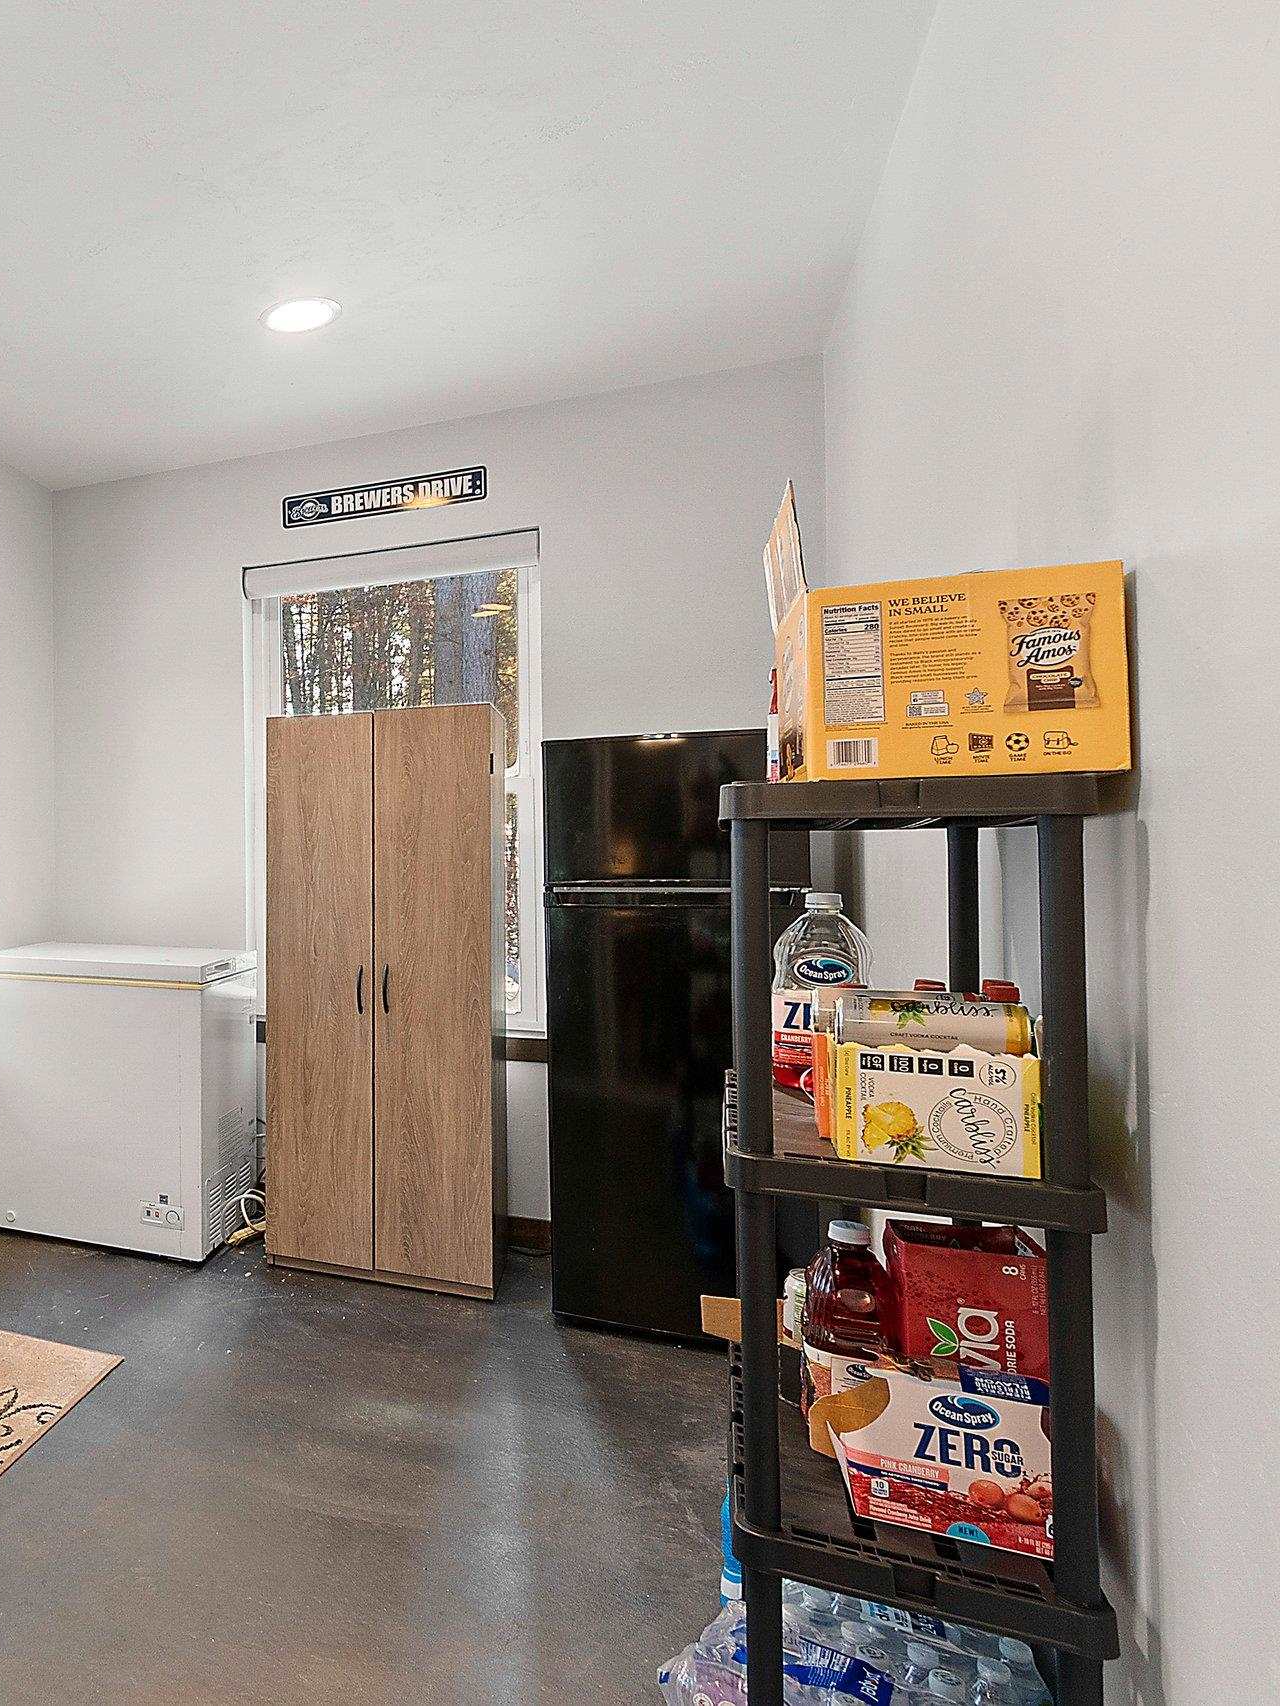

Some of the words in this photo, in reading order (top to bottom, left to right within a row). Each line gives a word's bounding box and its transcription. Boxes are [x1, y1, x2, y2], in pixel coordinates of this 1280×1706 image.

[331, 484, 415, 514] BREWERS
[418, 475, 473, 499] DRIVE
[888, 599, 909, 607] WE
[912, 593, 967, 605] BELIEVE
[888, 608, 902, 617] IN
[905, 605, 948, 615] SMALL
[1009, 629, 1081, 657] Famous
[1017, 645, 1073, 667] Amos
[800, 964, 823, 979] Ocean
[823, 969, 848, 980] Spray
[872, 1056, 882, 1069] GF
[898, 1057, 910, 1072] 100
[929, 1062, 939, 1070] 0
[959, 1065, 968, 1073] 0
[994, 1068, 1007, 1085] 5%
[949, 1087, 997, 1170] carbliss
[974, 1095, 1005, 1114] Hand
[994, 1116, 1014, 1156] Crafted
[1002, 1266, 1018, 1276] 8
[1019, 1264, 1027, 1280] CANS
[958, 1307, 1001, 1371] via
[1005, 1320, 1016, 1350] SODA
[932, 1401, 963, 1421] Ocean
[964, 1412, 995, 1425] Spray
[914, 1421, 1022, 1478] ZERO
[991, 1451, 1024, 1466] SUGAR
[880, 1458, 897, 1470] PINK
[898, 1462, 940, 1479] CRANBERRY
[875, 1480, 885, 1489] 10
[959, 1526, 980, 1537] NEW!
